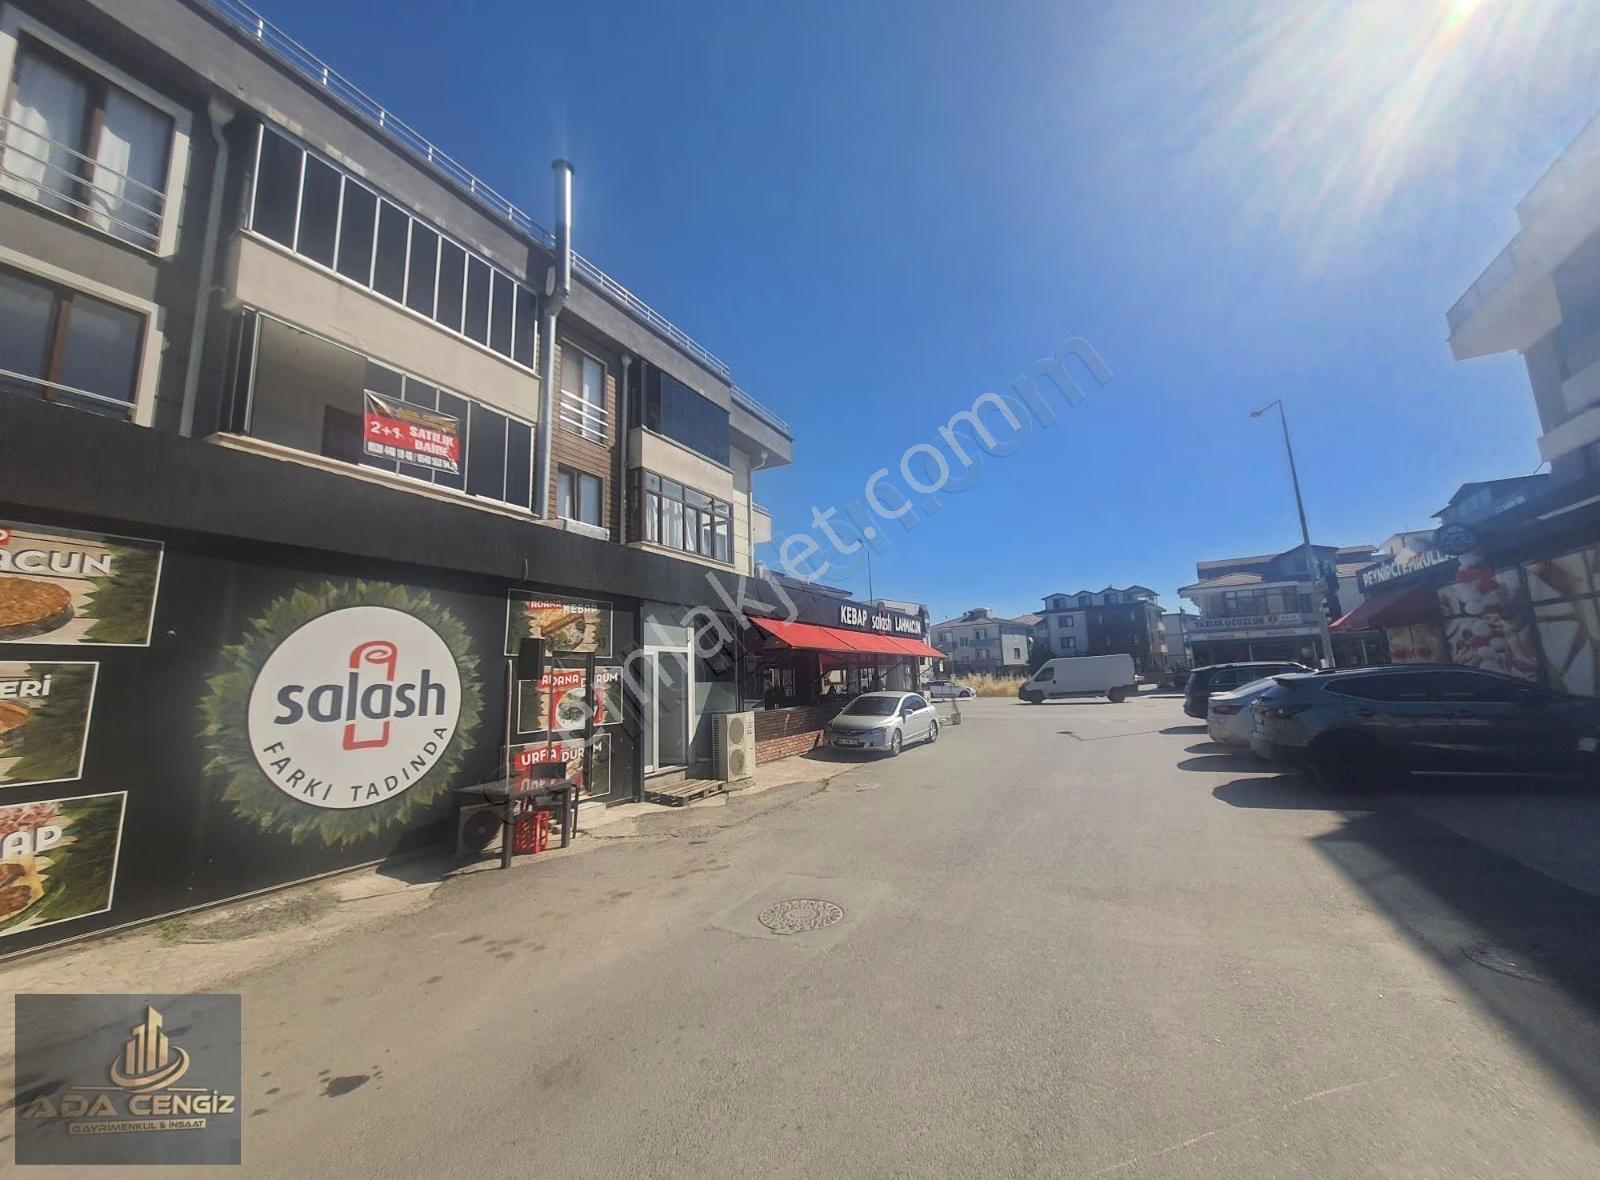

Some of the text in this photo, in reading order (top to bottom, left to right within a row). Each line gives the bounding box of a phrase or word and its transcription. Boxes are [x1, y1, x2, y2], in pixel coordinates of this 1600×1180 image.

[841, 605, 868, 626] KEBAP
[273, 669, 446, 725] salash
[581, 669, 618, 687] DRÜM
[264, 726, 448, 801] FARKI TADINDA
